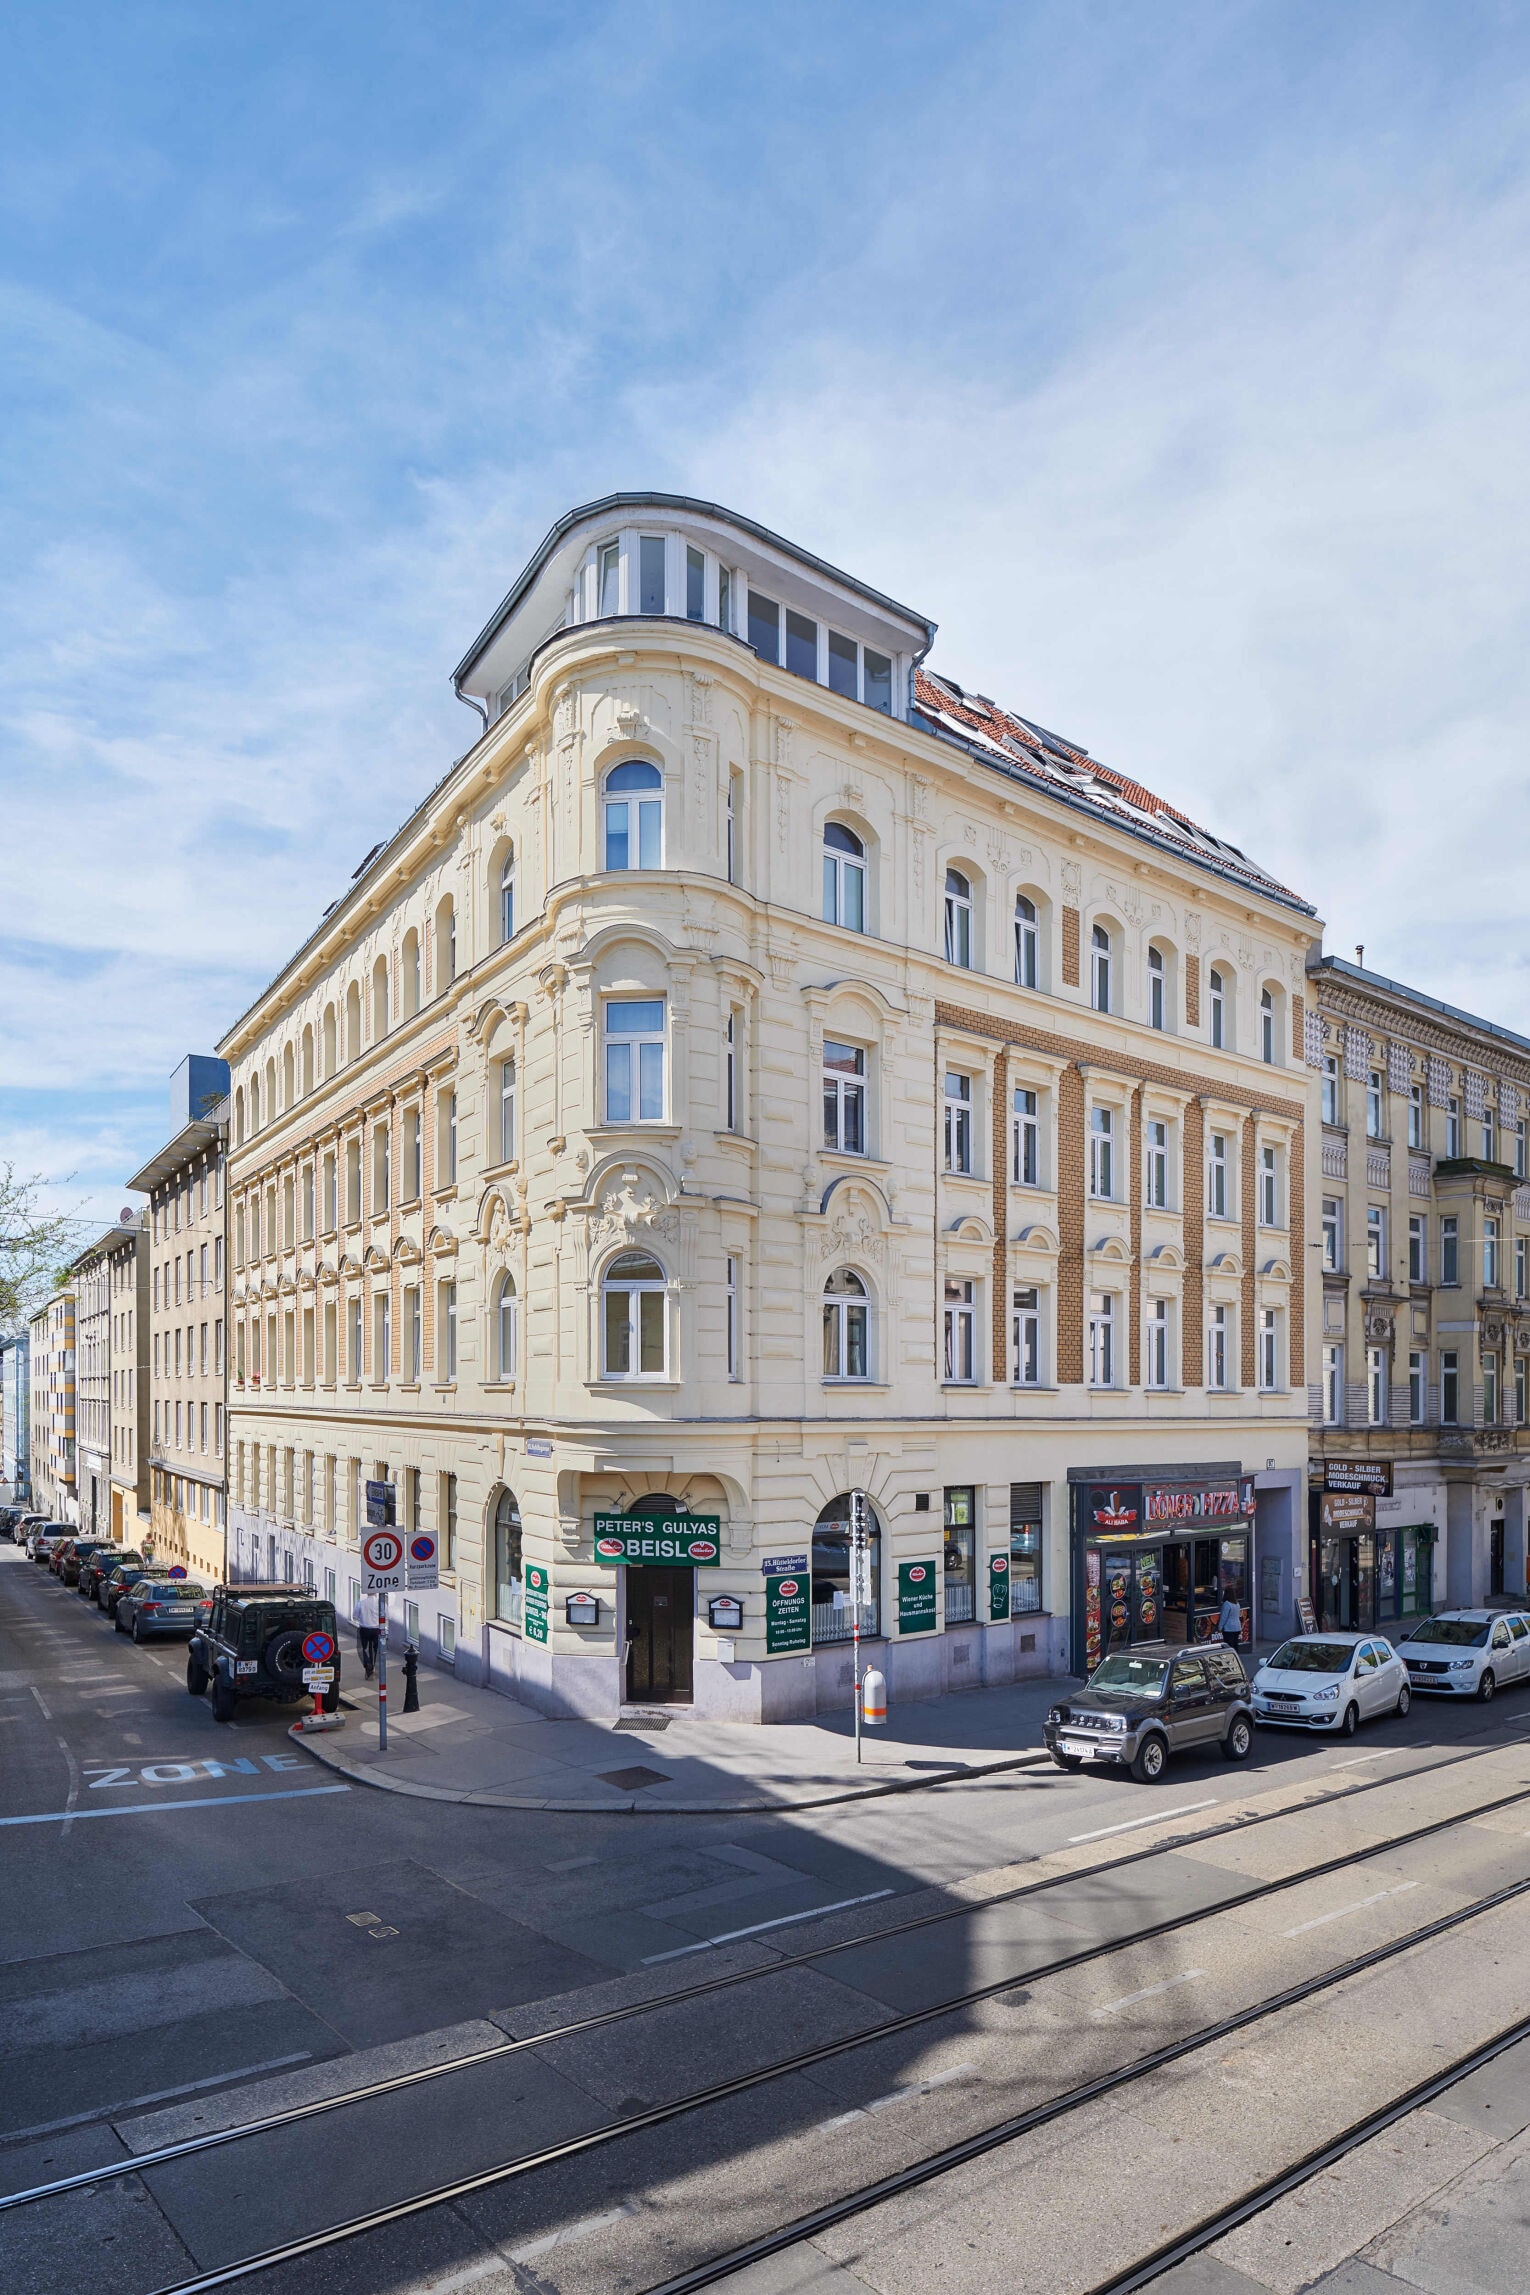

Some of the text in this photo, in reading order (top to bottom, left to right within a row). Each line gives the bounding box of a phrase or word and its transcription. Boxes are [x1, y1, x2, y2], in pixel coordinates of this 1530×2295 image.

[1328, 1463, 1348, 1471] GOLD
[1354, 1464, 1381, 1473] SILBER
[1328, 1472, 1386, 1483] MODESCHMUCK
[1328, 1480, 1362, 1489] VERKAUF
[1145, 1490, 1240, 1520] DÖNER PIZZA
[596, 1520, 717, 1535] PETER'S GULYAS
[374, 1543, 392, 1561] 30
[627, 1539, 687, 1558] BEISL
[367, 1574, 400, 1590] Zone
[772, 1597, 805, 1607] ÖFFNUNGS
[778, 1606, 800, 1614] ZEITEN
[310, 1684, 329, 1692] Anfang
[82, 1752, 315, 1789] ZONE
